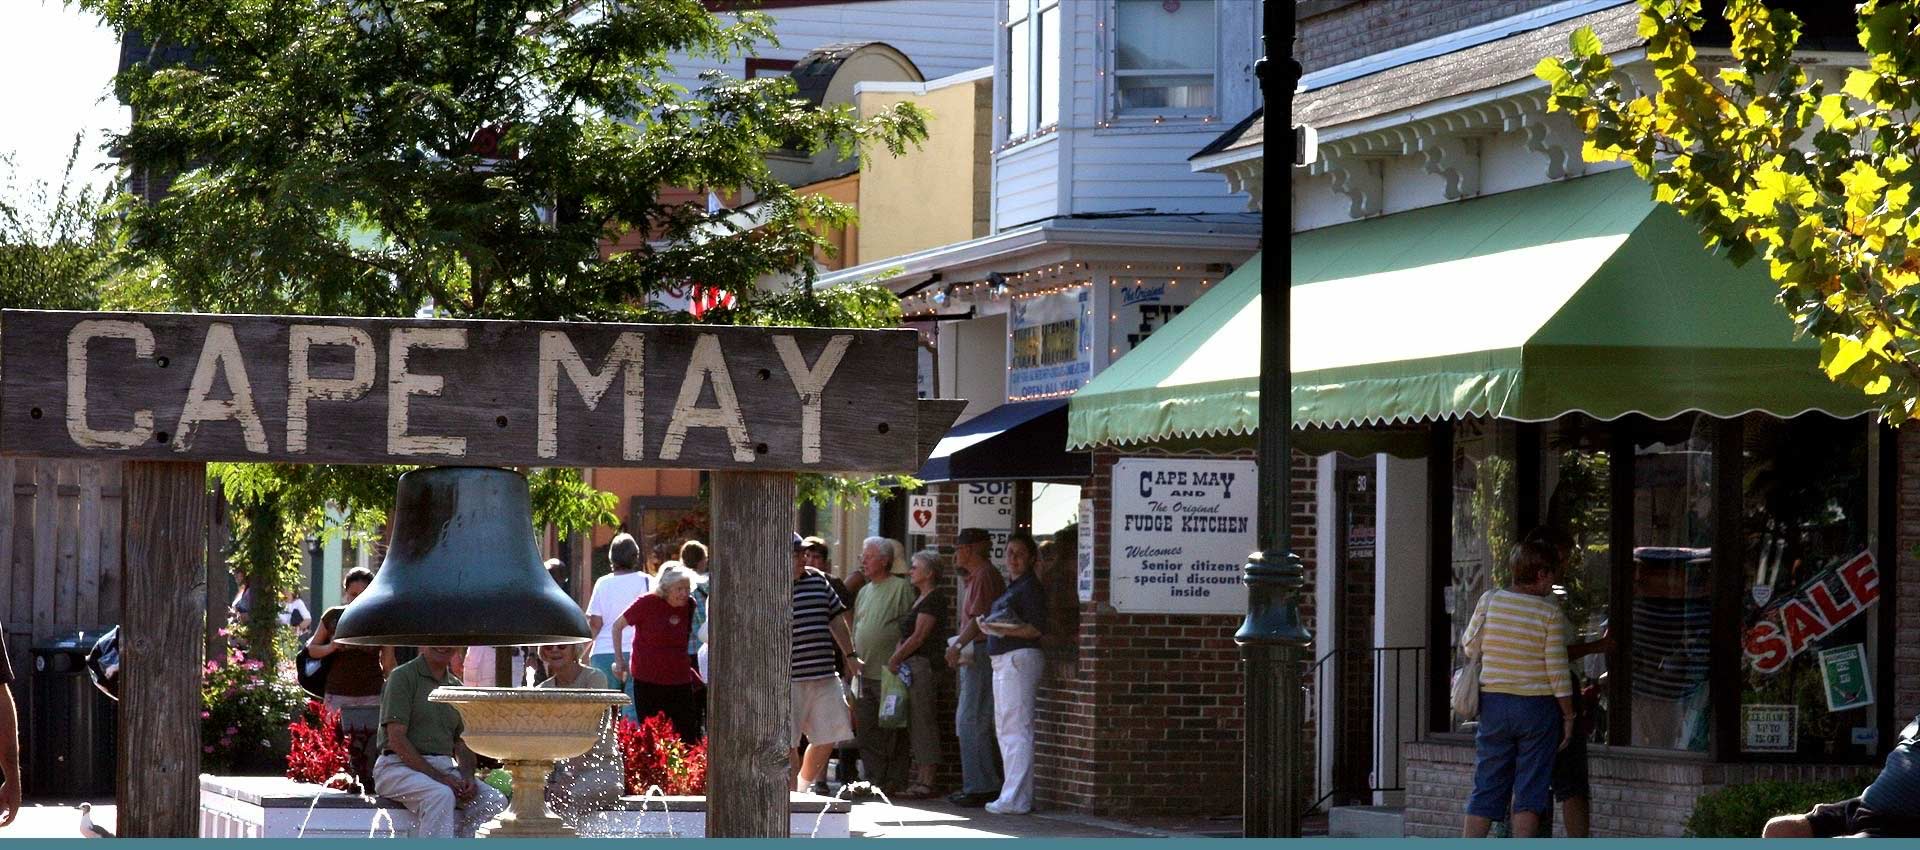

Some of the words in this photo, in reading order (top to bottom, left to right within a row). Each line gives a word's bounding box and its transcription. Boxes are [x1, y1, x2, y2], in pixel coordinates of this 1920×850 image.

[1121, 287, 1134, 303] The
[1135, 282, 1165, 299] Original
[67, 319, 468, 458] CAPE
[537, 330, 854, 464] MAY
[1140, 471, 1187, 498] CAPE
[1192, 472, 1235, 499] MAY
[913, 496, 933, 507] AED
[974, 496, 995, 505] ICE
[1000, 496, 1012, 505] C
[1148, 501, 1168, 513] The
[1172, 501, 1220, 516] Original
[1125, 515, 1173, 532] FUDGE
[1182, 515, 1249, 533] KITCHEN
[1125, 545, 1182, 558] Welcomes
[1142, 560, 1183, 572] Senior
[1190, 560, 1240, 572] citizens
[1134, 573, 1178, 586] special
[1186, 574, 1244, 585] discount
[1170, 586, 1210, 597] inside
[1746, 550, 1880, 673] SALE
